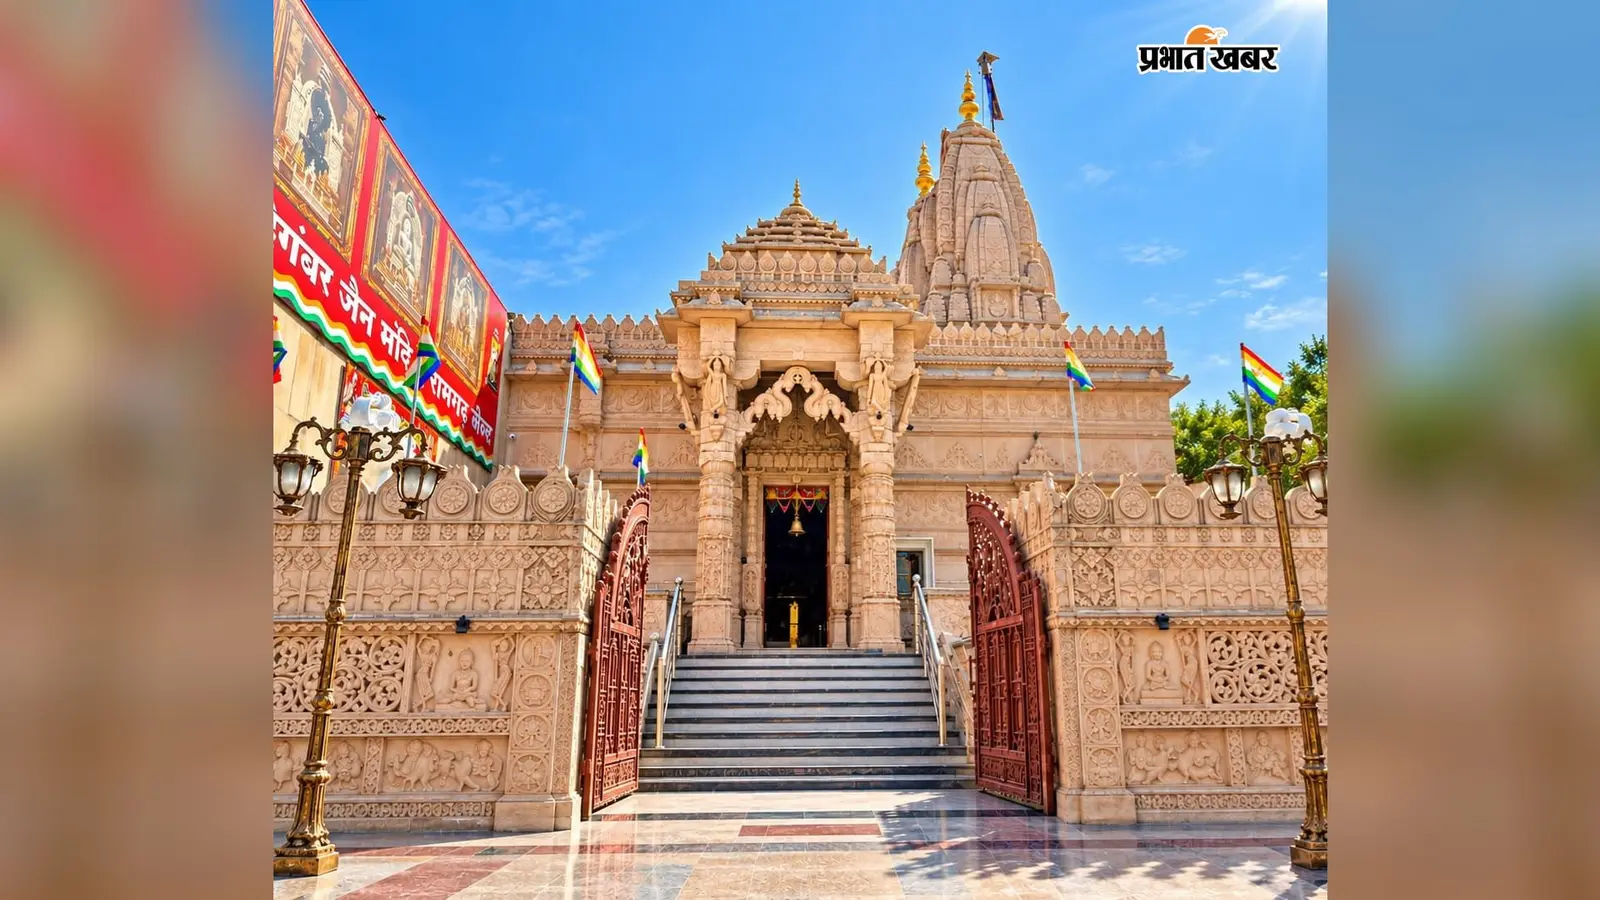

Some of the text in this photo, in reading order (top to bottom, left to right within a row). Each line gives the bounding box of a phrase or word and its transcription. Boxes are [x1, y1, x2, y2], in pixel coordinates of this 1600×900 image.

[273, 204, 334, 297] गंबर
[338, 273, 377, 338] जैन
[380, 319, 415, 372] मंदि
